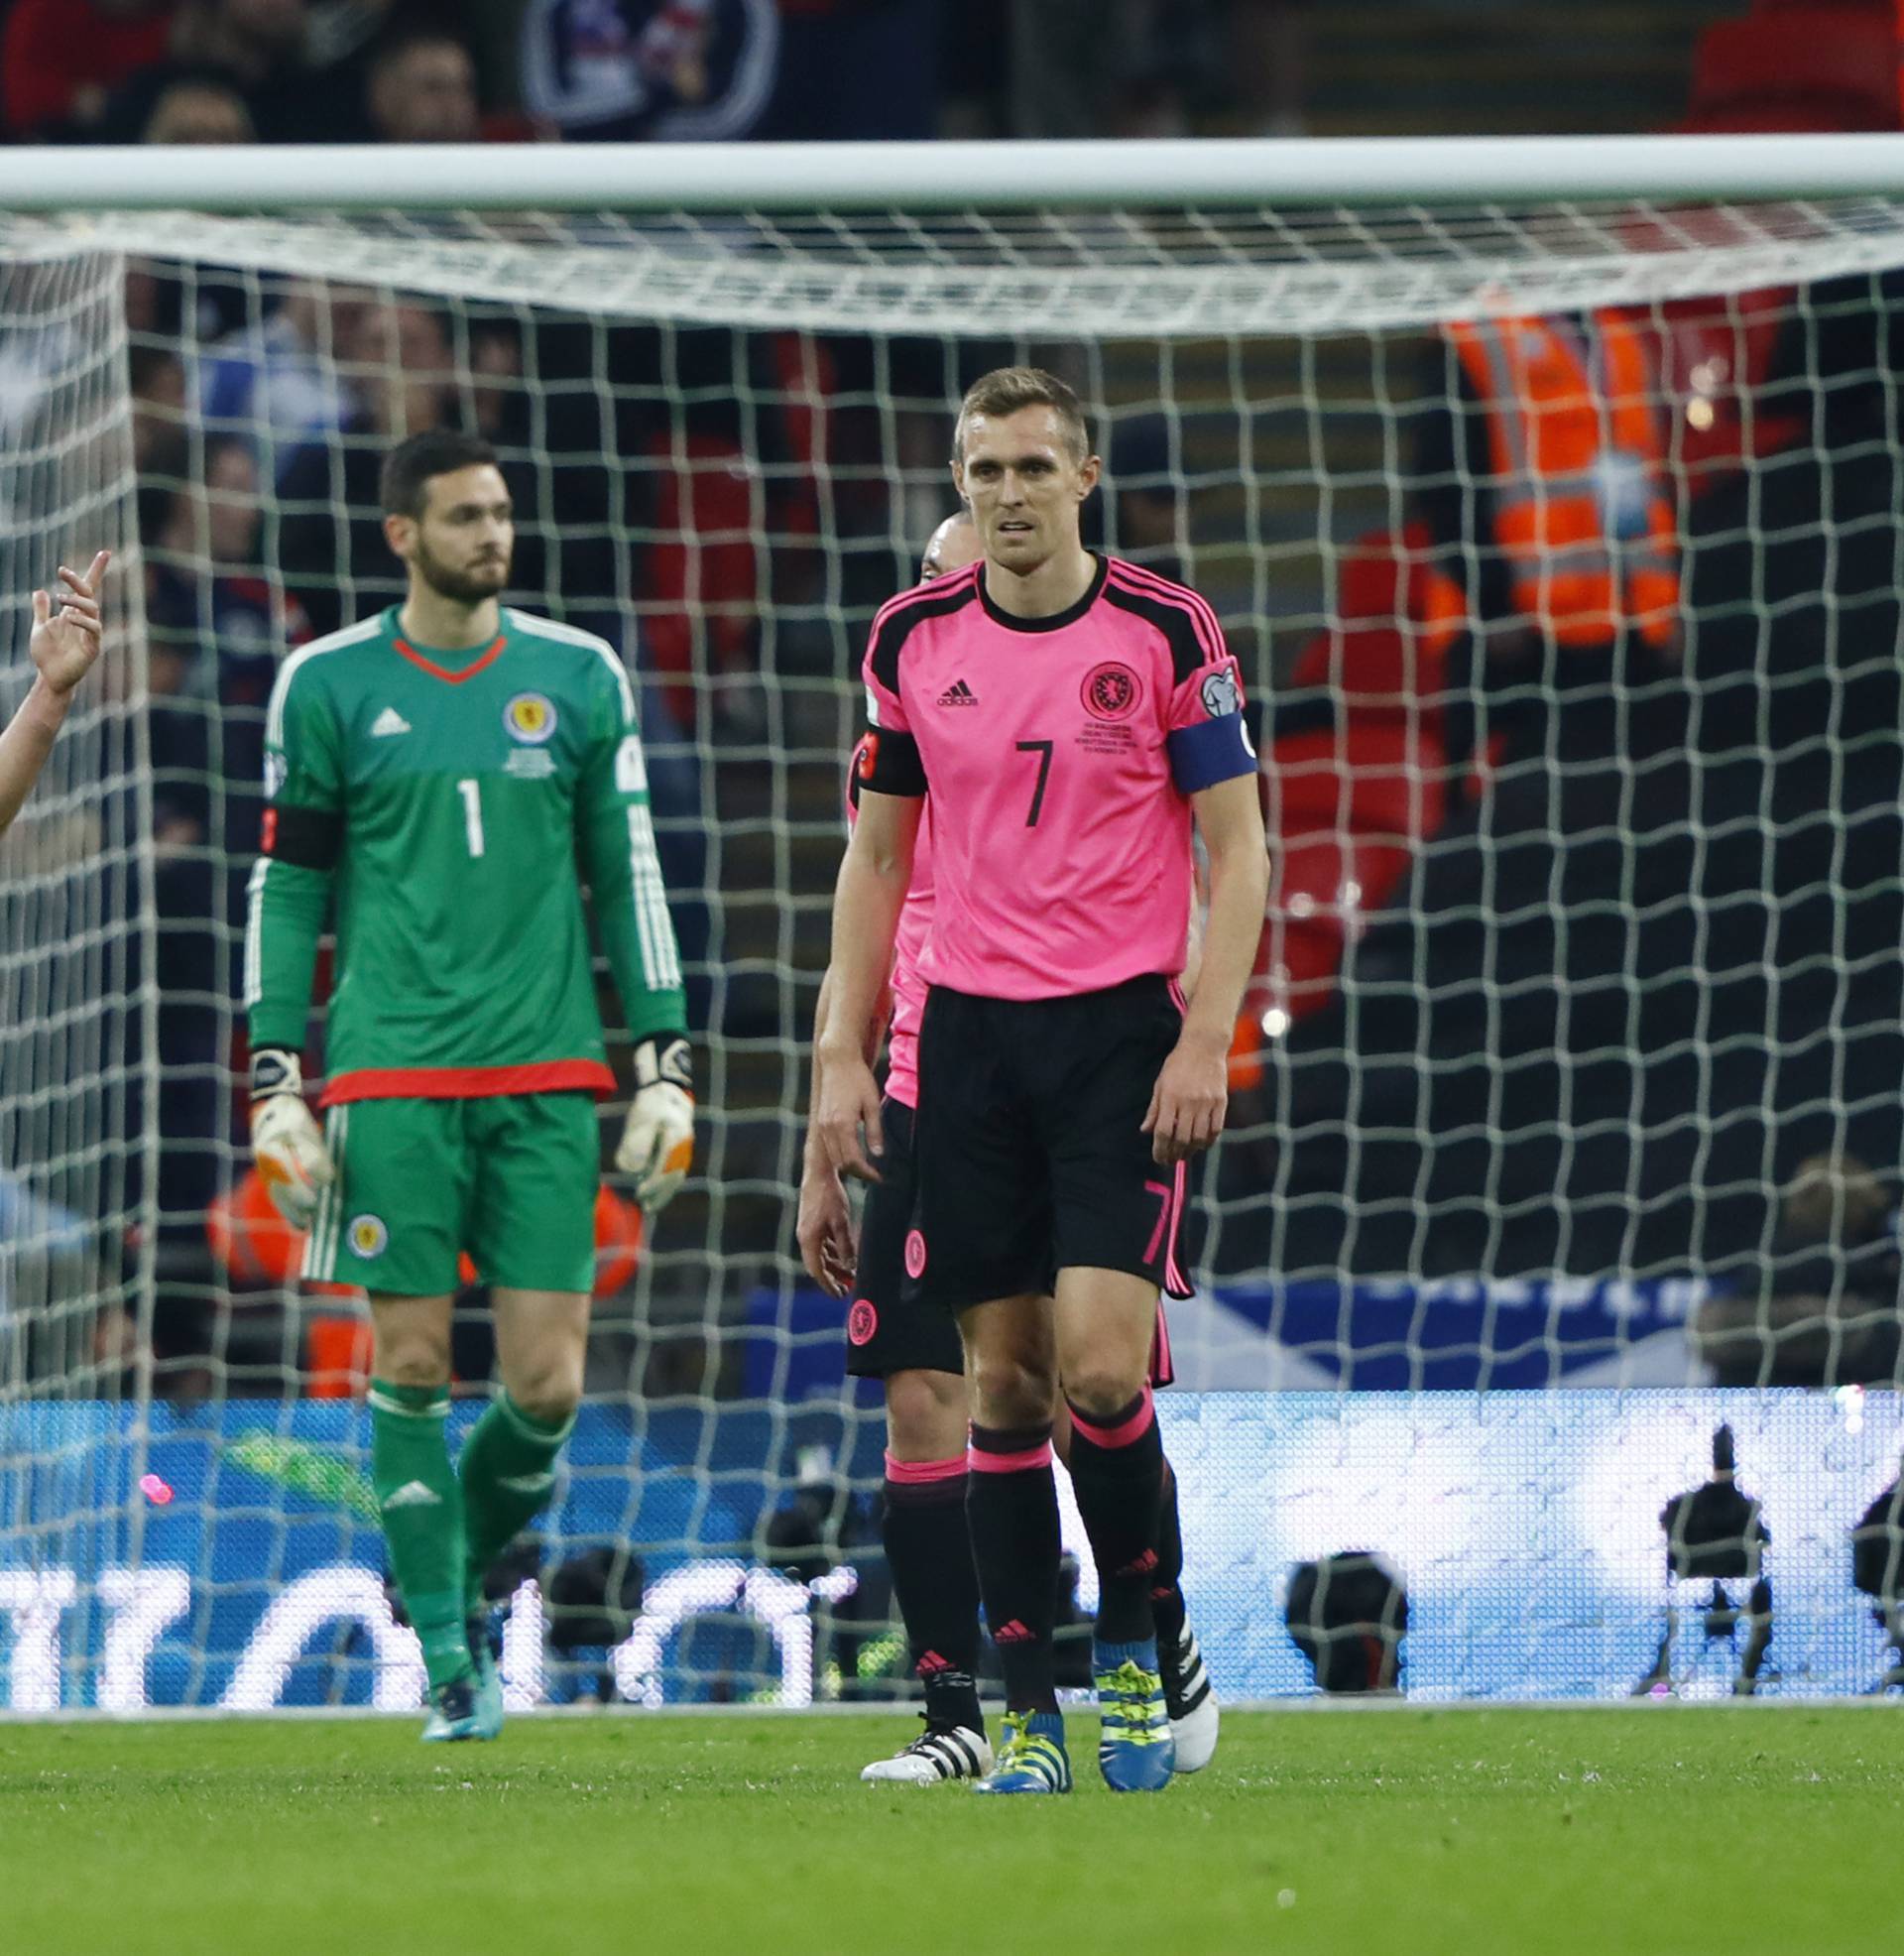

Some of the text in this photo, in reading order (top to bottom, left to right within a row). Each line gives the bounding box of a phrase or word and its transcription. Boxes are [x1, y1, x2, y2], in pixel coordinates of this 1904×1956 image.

[937, 696, 979, 706] adidas
[457, 779, 485, 858] 1
[1015, 741, 1053, 827] 7
[1142, 1179, 1171, 1265] 7
